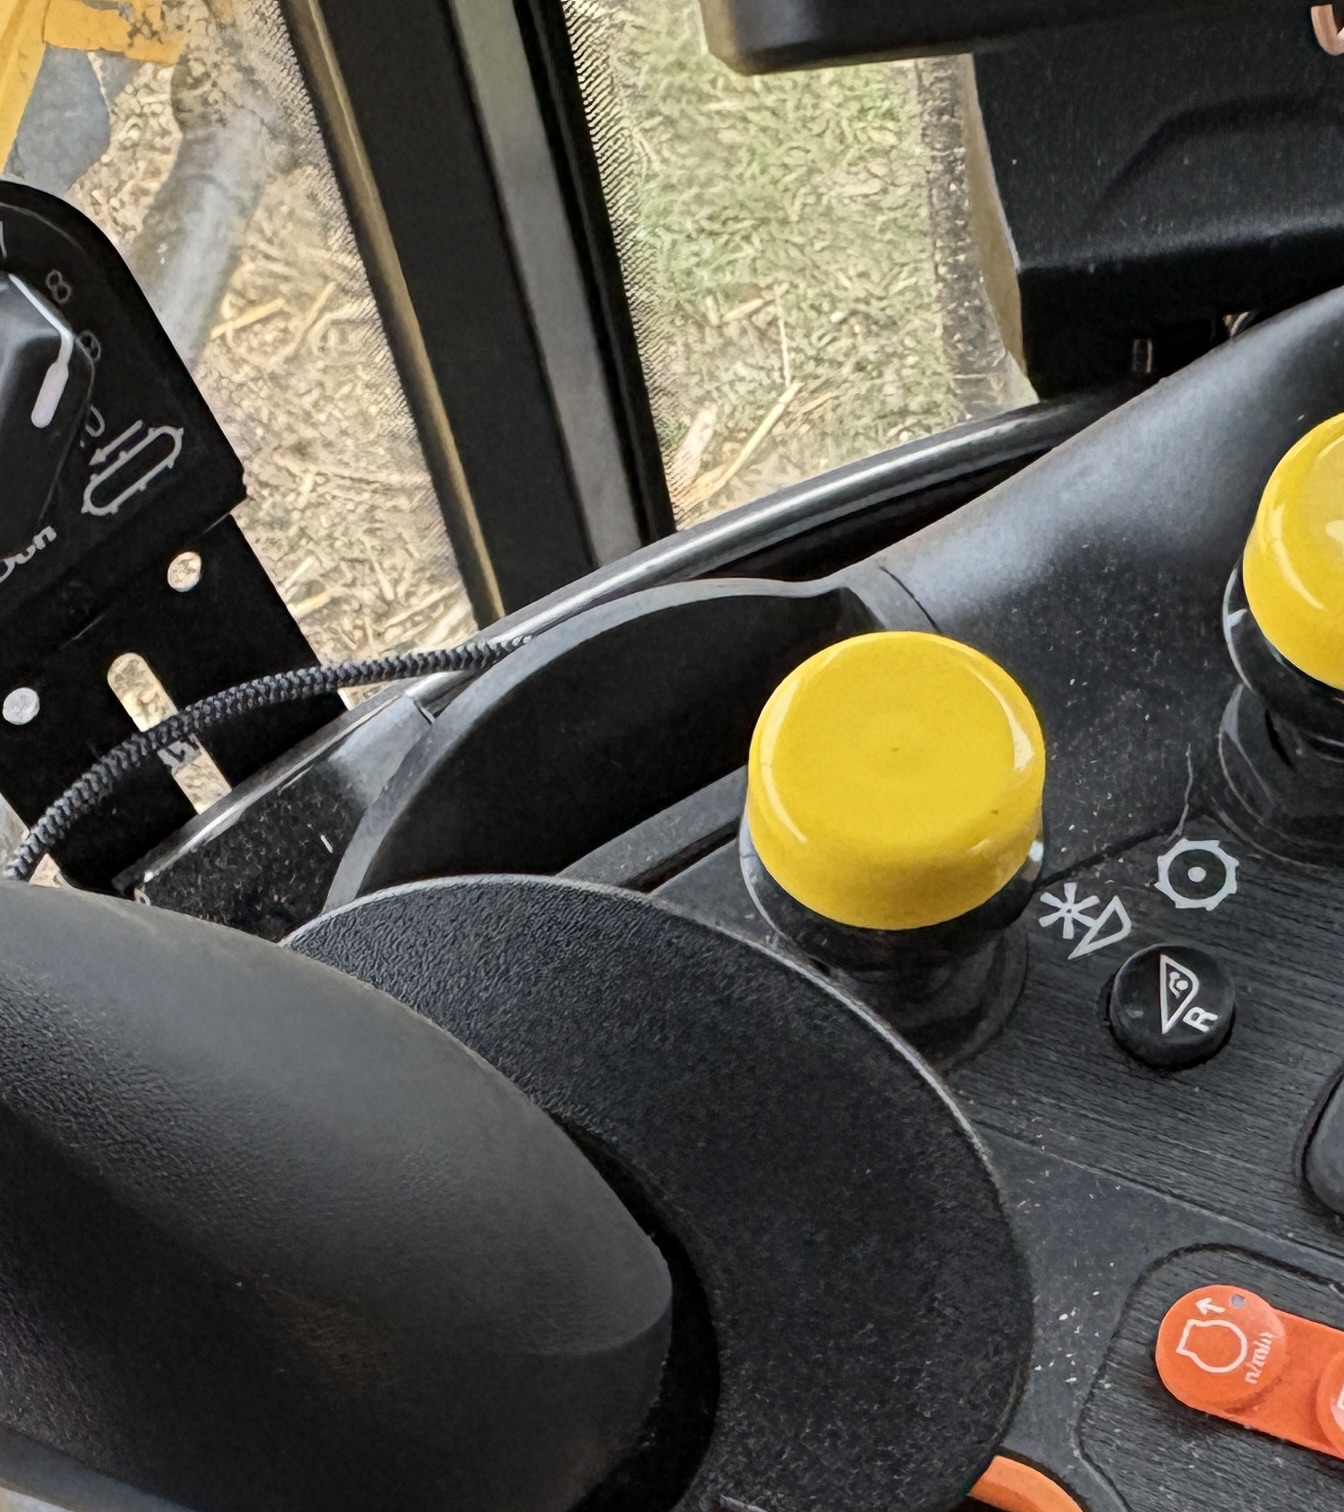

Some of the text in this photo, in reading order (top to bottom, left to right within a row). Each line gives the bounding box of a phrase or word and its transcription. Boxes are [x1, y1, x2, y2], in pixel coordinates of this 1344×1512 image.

[45, 268, 72, 304] 8
[1182, 1006, 1220, 1034] R
[1243, 1330, 1275, 1386] n/min
